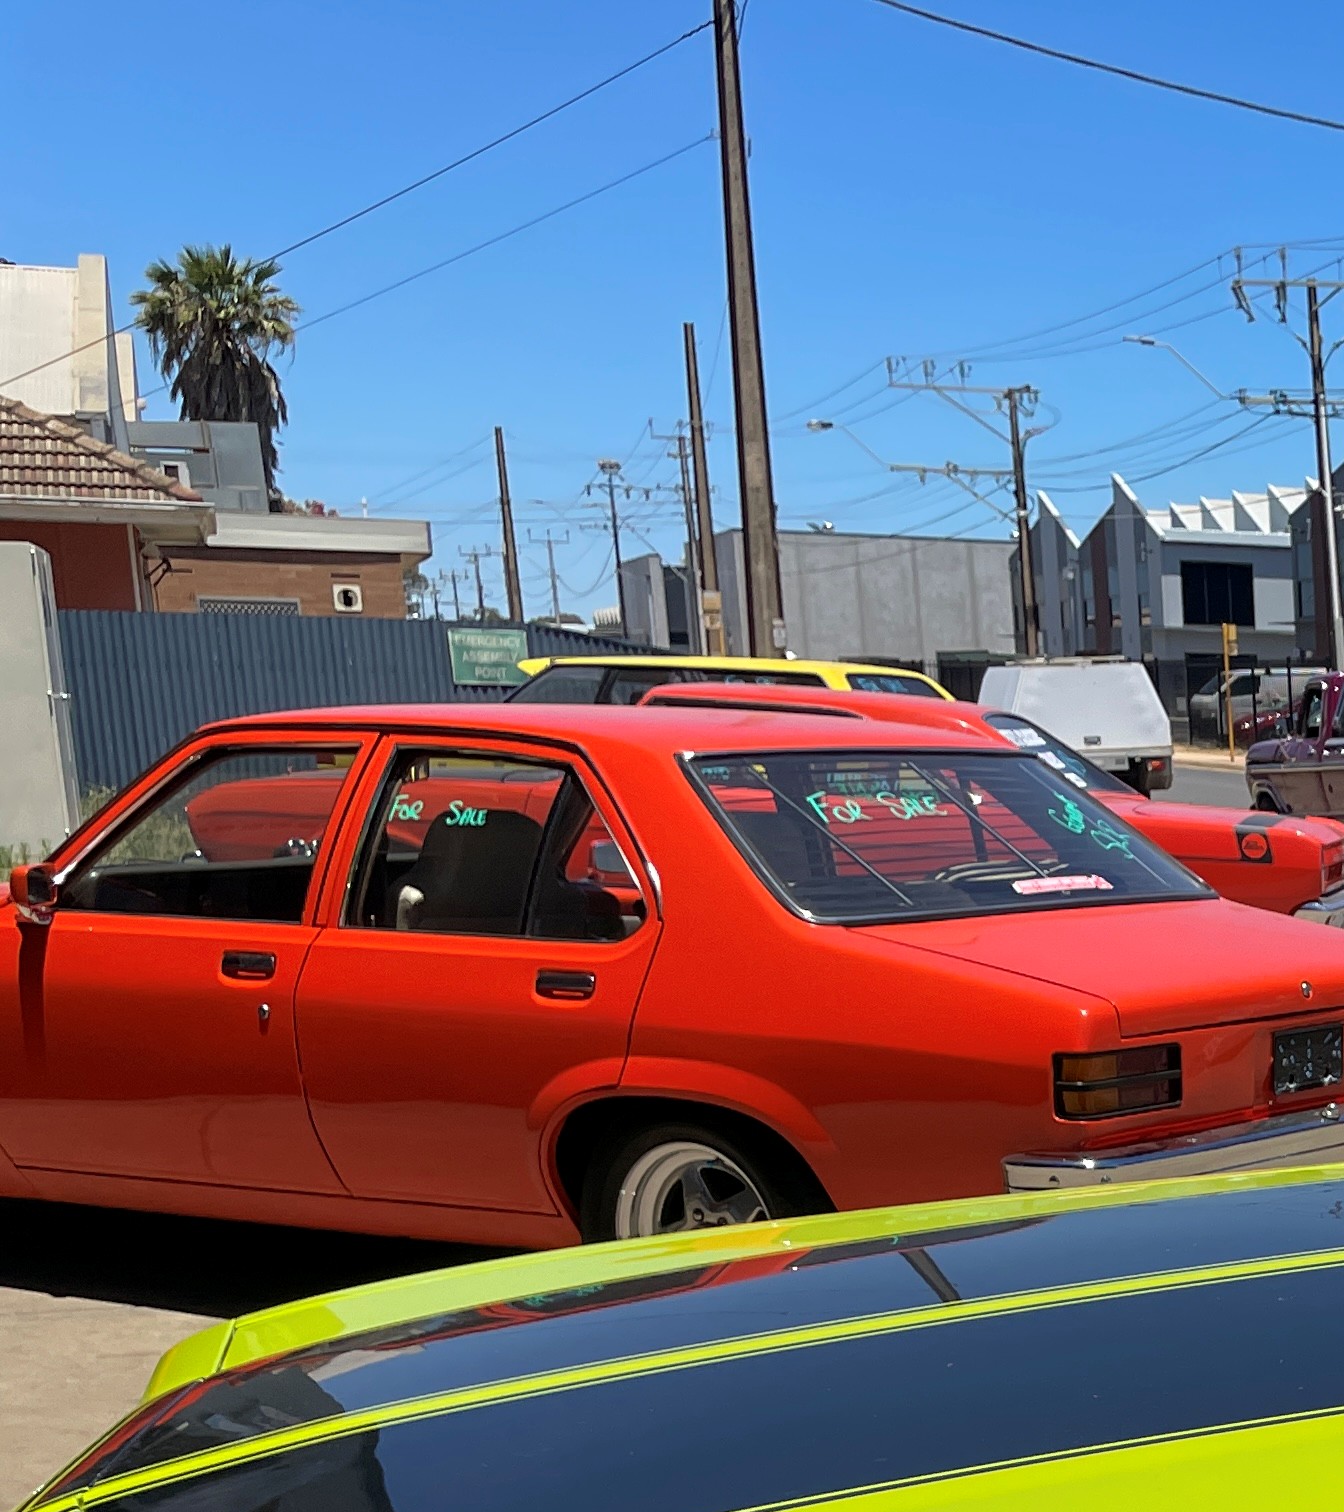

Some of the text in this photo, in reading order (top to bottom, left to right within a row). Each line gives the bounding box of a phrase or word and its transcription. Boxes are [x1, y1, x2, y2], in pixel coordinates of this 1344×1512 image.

[454, 634, 521, 649] EMERGENCY
[462, 650, 519, 664] ASSEMBLY
[474, 666, 507, 680] POINT
[388, 793, 488, 826] FOR SALE
[805, 790, 948, 824] FOR SALE
